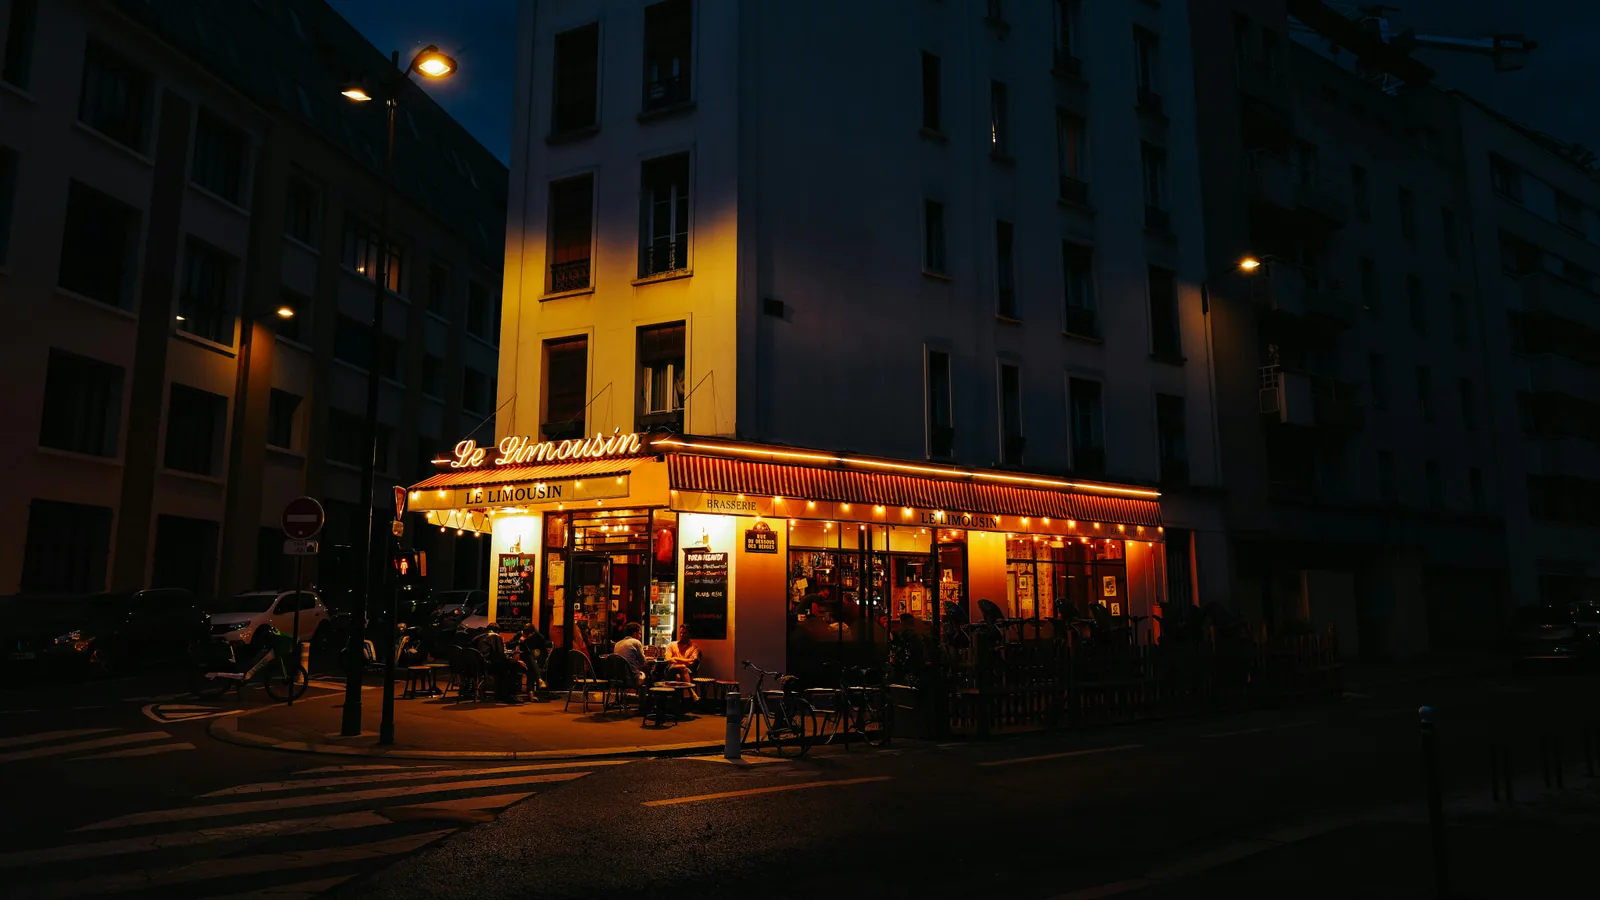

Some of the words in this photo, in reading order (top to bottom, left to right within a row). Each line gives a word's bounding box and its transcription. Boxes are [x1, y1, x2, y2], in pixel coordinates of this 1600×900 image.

[451, 440, 484, 467] Le
[495, 427, 641, 465] Limousin
[466, 491, 483, 504] LE
[488, 485, 562, 503] LIMOUSIN
[707, 499, 757, 511] BRASSERIE
[921, 512, 936, 524] LE
[940, 513, 997, 528] LIMOUSIN
